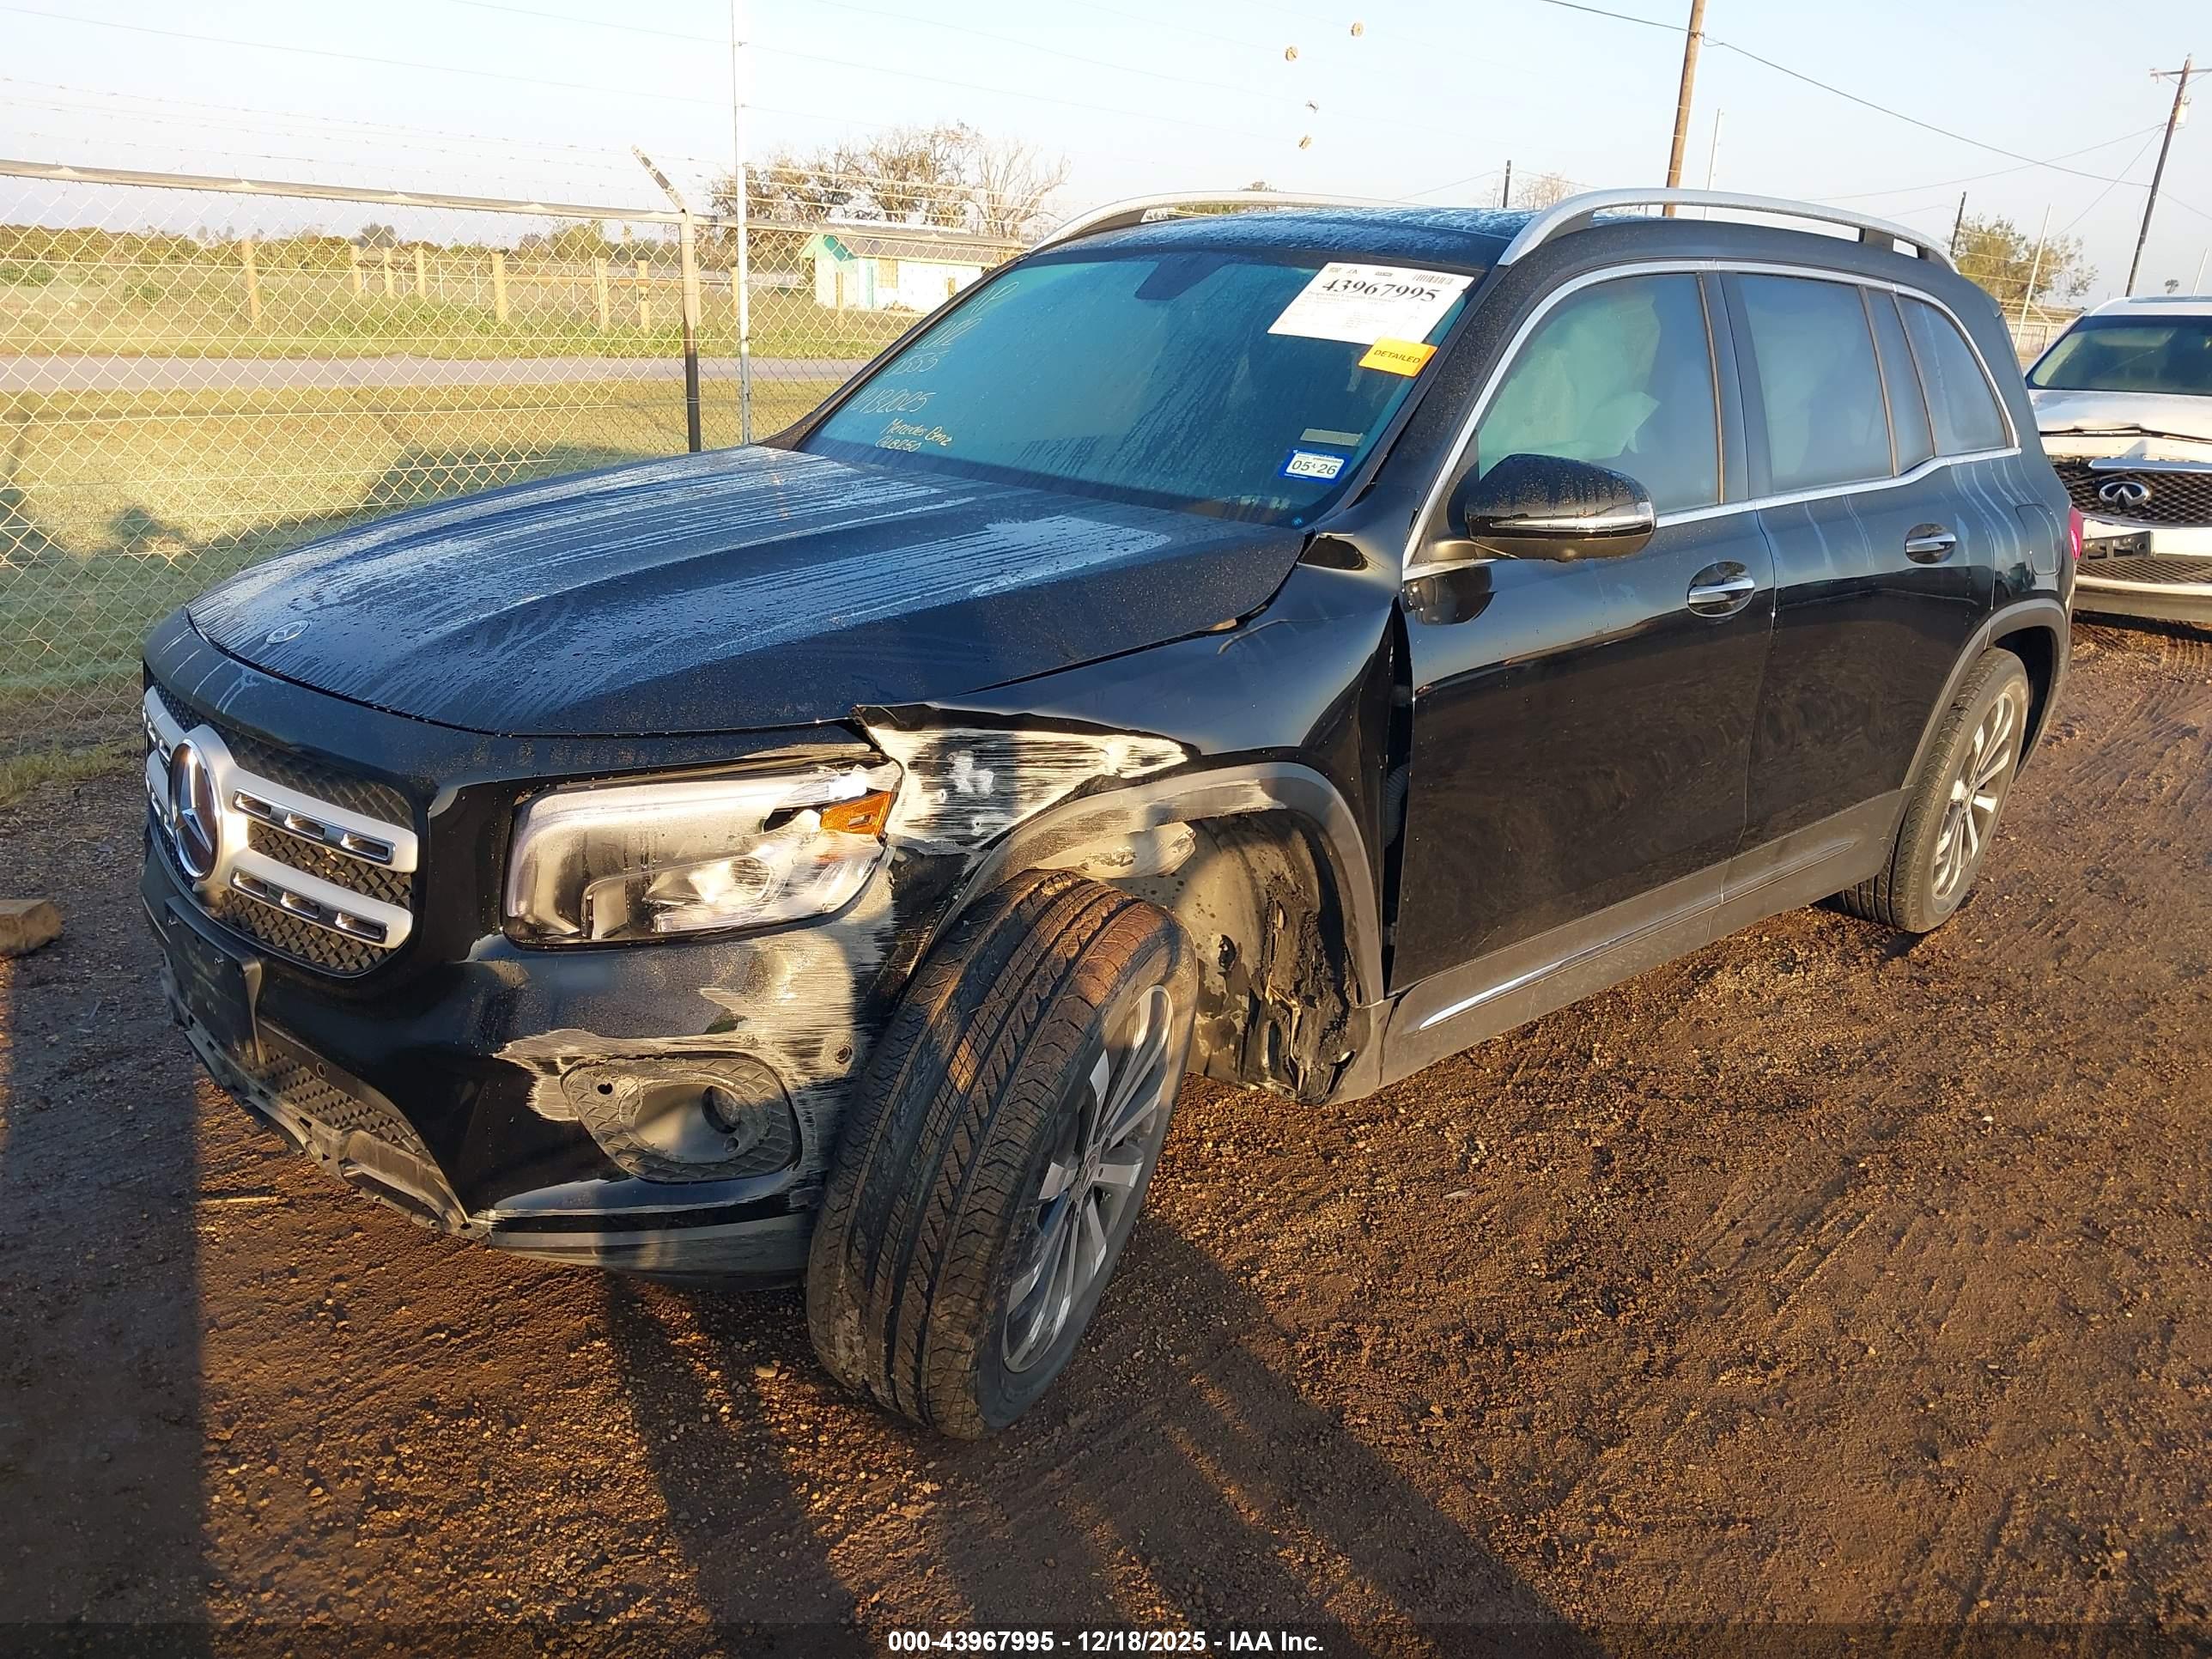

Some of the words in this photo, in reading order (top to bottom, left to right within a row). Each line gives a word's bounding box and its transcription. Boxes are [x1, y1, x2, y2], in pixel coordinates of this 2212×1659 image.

[1322, 278, 1443, 302] 43967995
[1373, 349, 1421, 364] DETAILED
[924, 426, 953, 447] Benz
[1291, 459, 1312, 471] 05
[1316, 463, 1338, 475] 26
